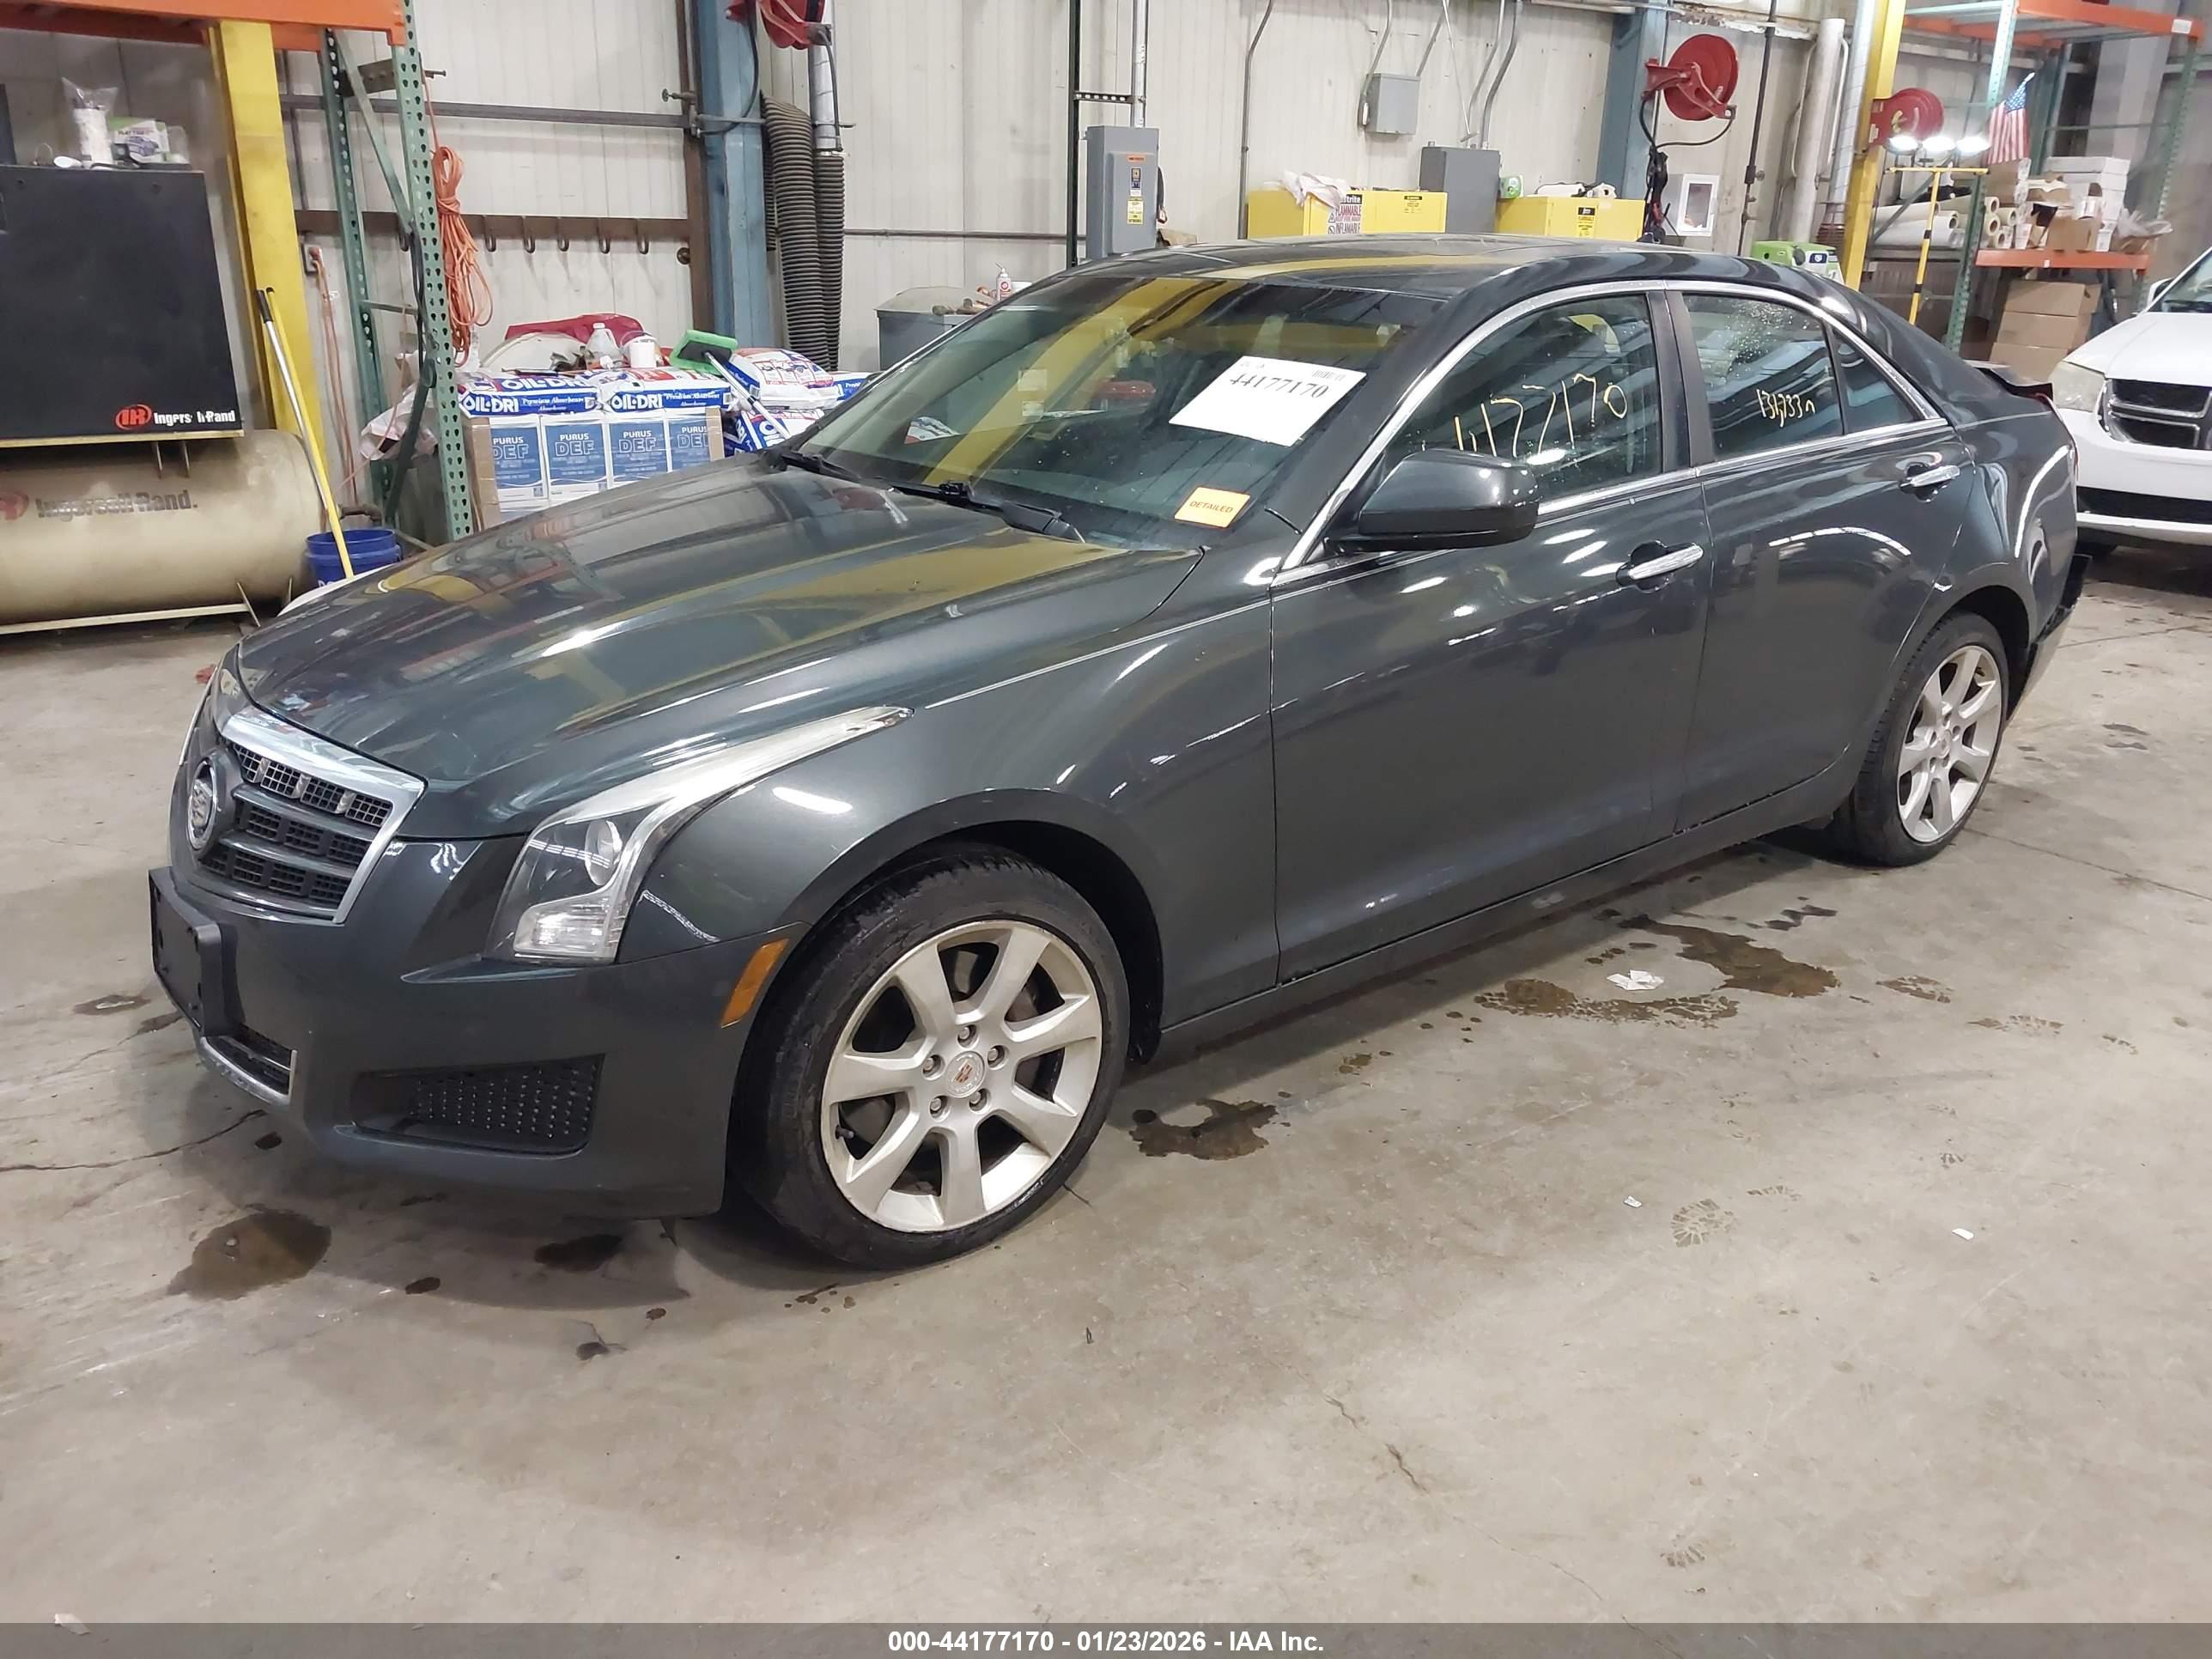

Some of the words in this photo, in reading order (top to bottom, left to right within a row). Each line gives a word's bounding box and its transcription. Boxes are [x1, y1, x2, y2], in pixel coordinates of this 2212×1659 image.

[1229, 373, 1329, 398] 44177170
[493, 436, 524, 445] PURUS
[560, 433, 590, 441] PURUS
[623, 430, 652, 439] PURUS
[492, 444, 529, 460] DEF
[555, 441, 594, 457] DEF
[618, 437, 657, 453] DEF
[1189, 501, 1234, 514] DETAILED
